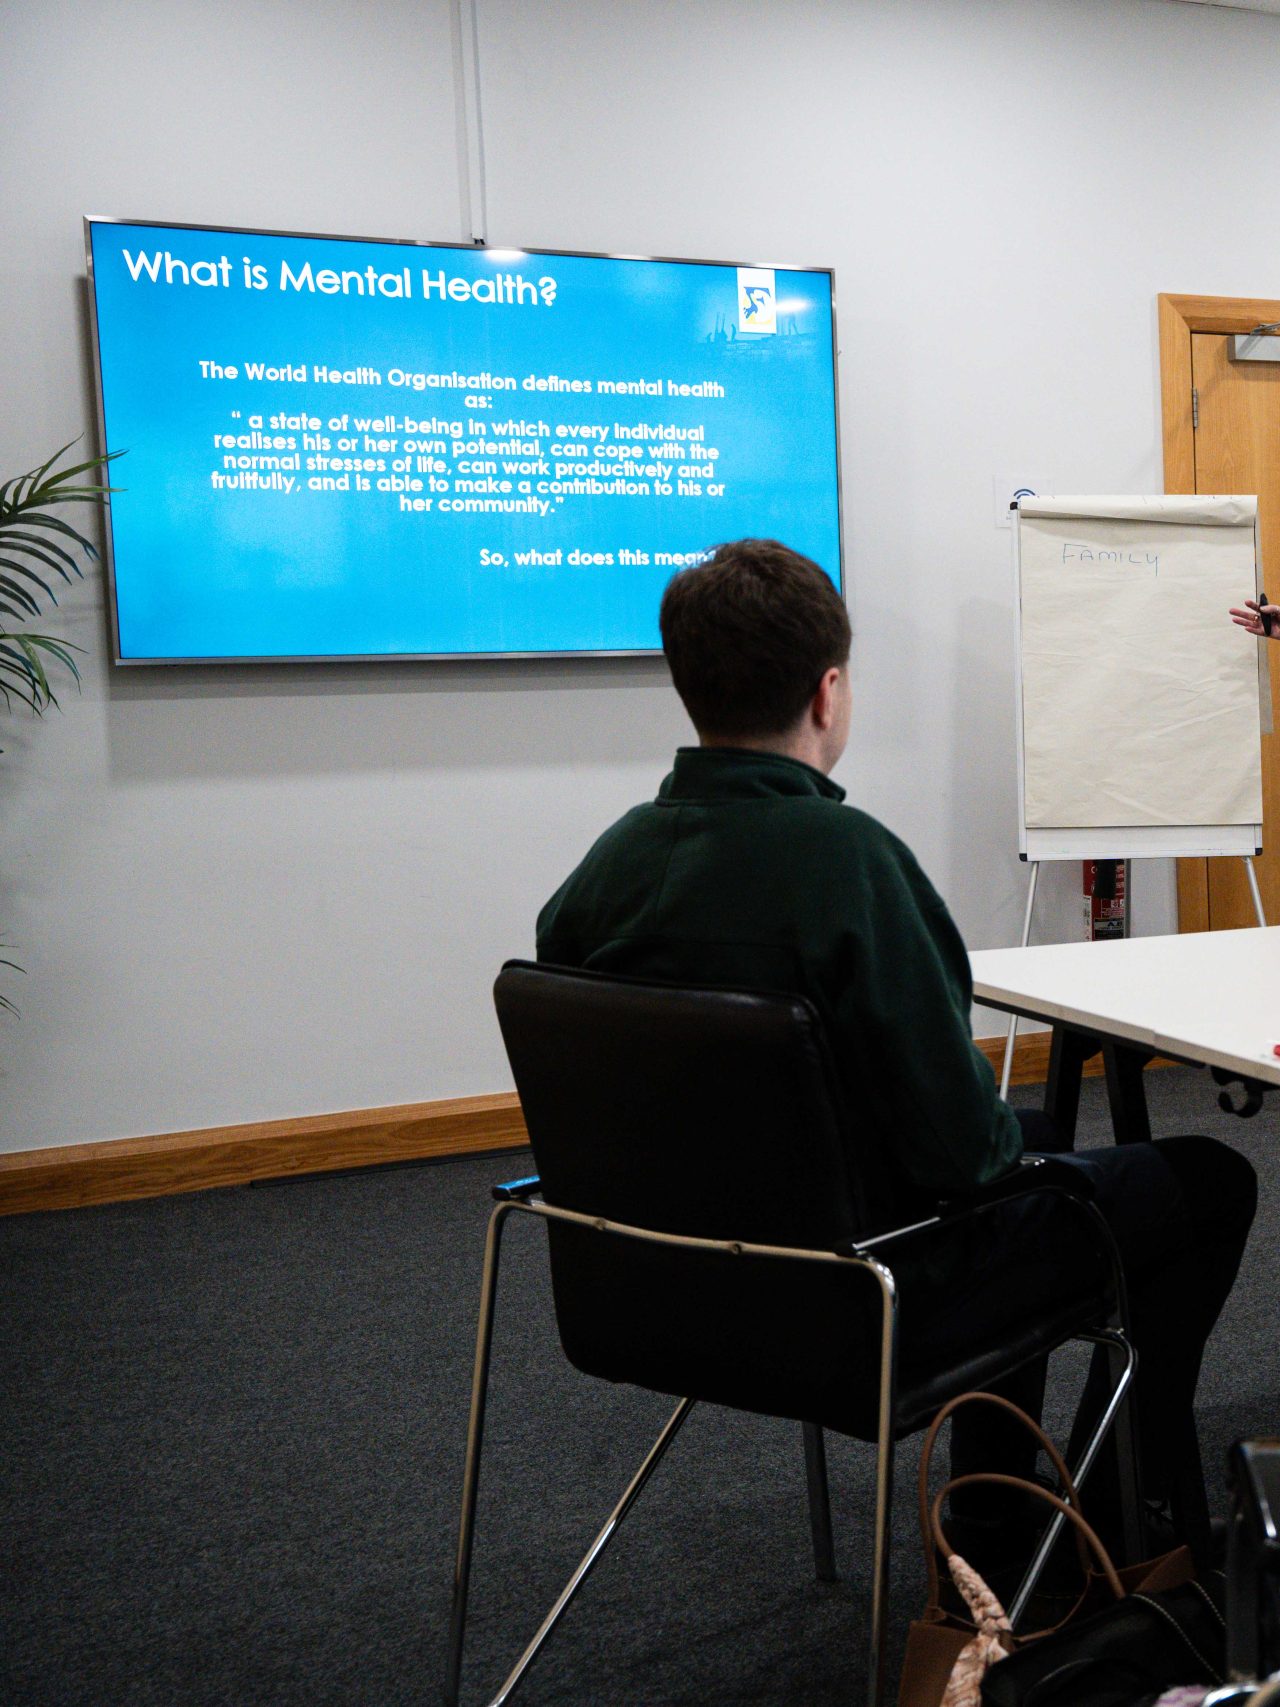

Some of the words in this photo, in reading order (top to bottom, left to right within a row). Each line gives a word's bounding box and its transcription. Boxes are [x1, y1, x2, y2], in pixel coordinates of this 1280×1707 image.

[123, 250, 232, 287] What
[243, 257, 268, 289] is
[280, 261, 411, 297] Mental
[423, 270, 557, 306] Health?
[199, 361, 238, 379] The
[245, 363, 306, 382] World
[314, 366, 381, 385] Health
[388, 369, 516, 390] Organisation
[522, 375, 592, 392] defines
[598, 379, 662, 395] mental
[668, 380, 724, 397] health
[465, 395, 492, 408] as:
[249, 416, 263, 428] a
[270, 412, 322, 430] state
[328, 415, 348, 431] of
[354, 416, 463, 438] well-being
[469, 418, 486, 435] in
[491, 419, 550, 436] which
[556, 425, 609, 442] every
[614, 423, 704, 441] individual
[214, 432, 296, 450] realises
[303, 433, 331, 451] his
[337, 438, 358, 451] or
[364, 435, 398, 452] her
[404, 440, 446, 453] own
[452, 438, 544, 458] potential,
[550, 444, 588, 456] can
[593, 445, 643, 461] cope
[648, 442, 685, 459] with
[689, 443, 719, 460] the
[224, 453, 300, 470] normal
[306, 453, 386, 472] stresses
[392, 456, 412, 472] of
[417, 456, 451, 475] life,
[458, 461, 497, 474] can
[502, 459, 550, 474] work
[555, 460, 673, 481] productively
[677, 462, 714, 478] and
[211, 471, 301, 495] fruitfully,
[308, 474, 350, 491] and
[356, 474, 371, 491] is
[377, 474, 423, 491] able
[429, 475, 449, 492] to
[455, 476, 512, 493] make
[518, 481, 531, 493] a
[537, 478, 649, 495] contribution
[654, 480, 672, 495] to
[678, 480, 702, 496] his
[707, 484, 725, 496] or
[400, 494, 433, 511] her
[480, 549, 508, 567] So,
[514, 549, 562, 565] what
[567, 549, 614, 565] does
[618, 549, 649, 565] this
